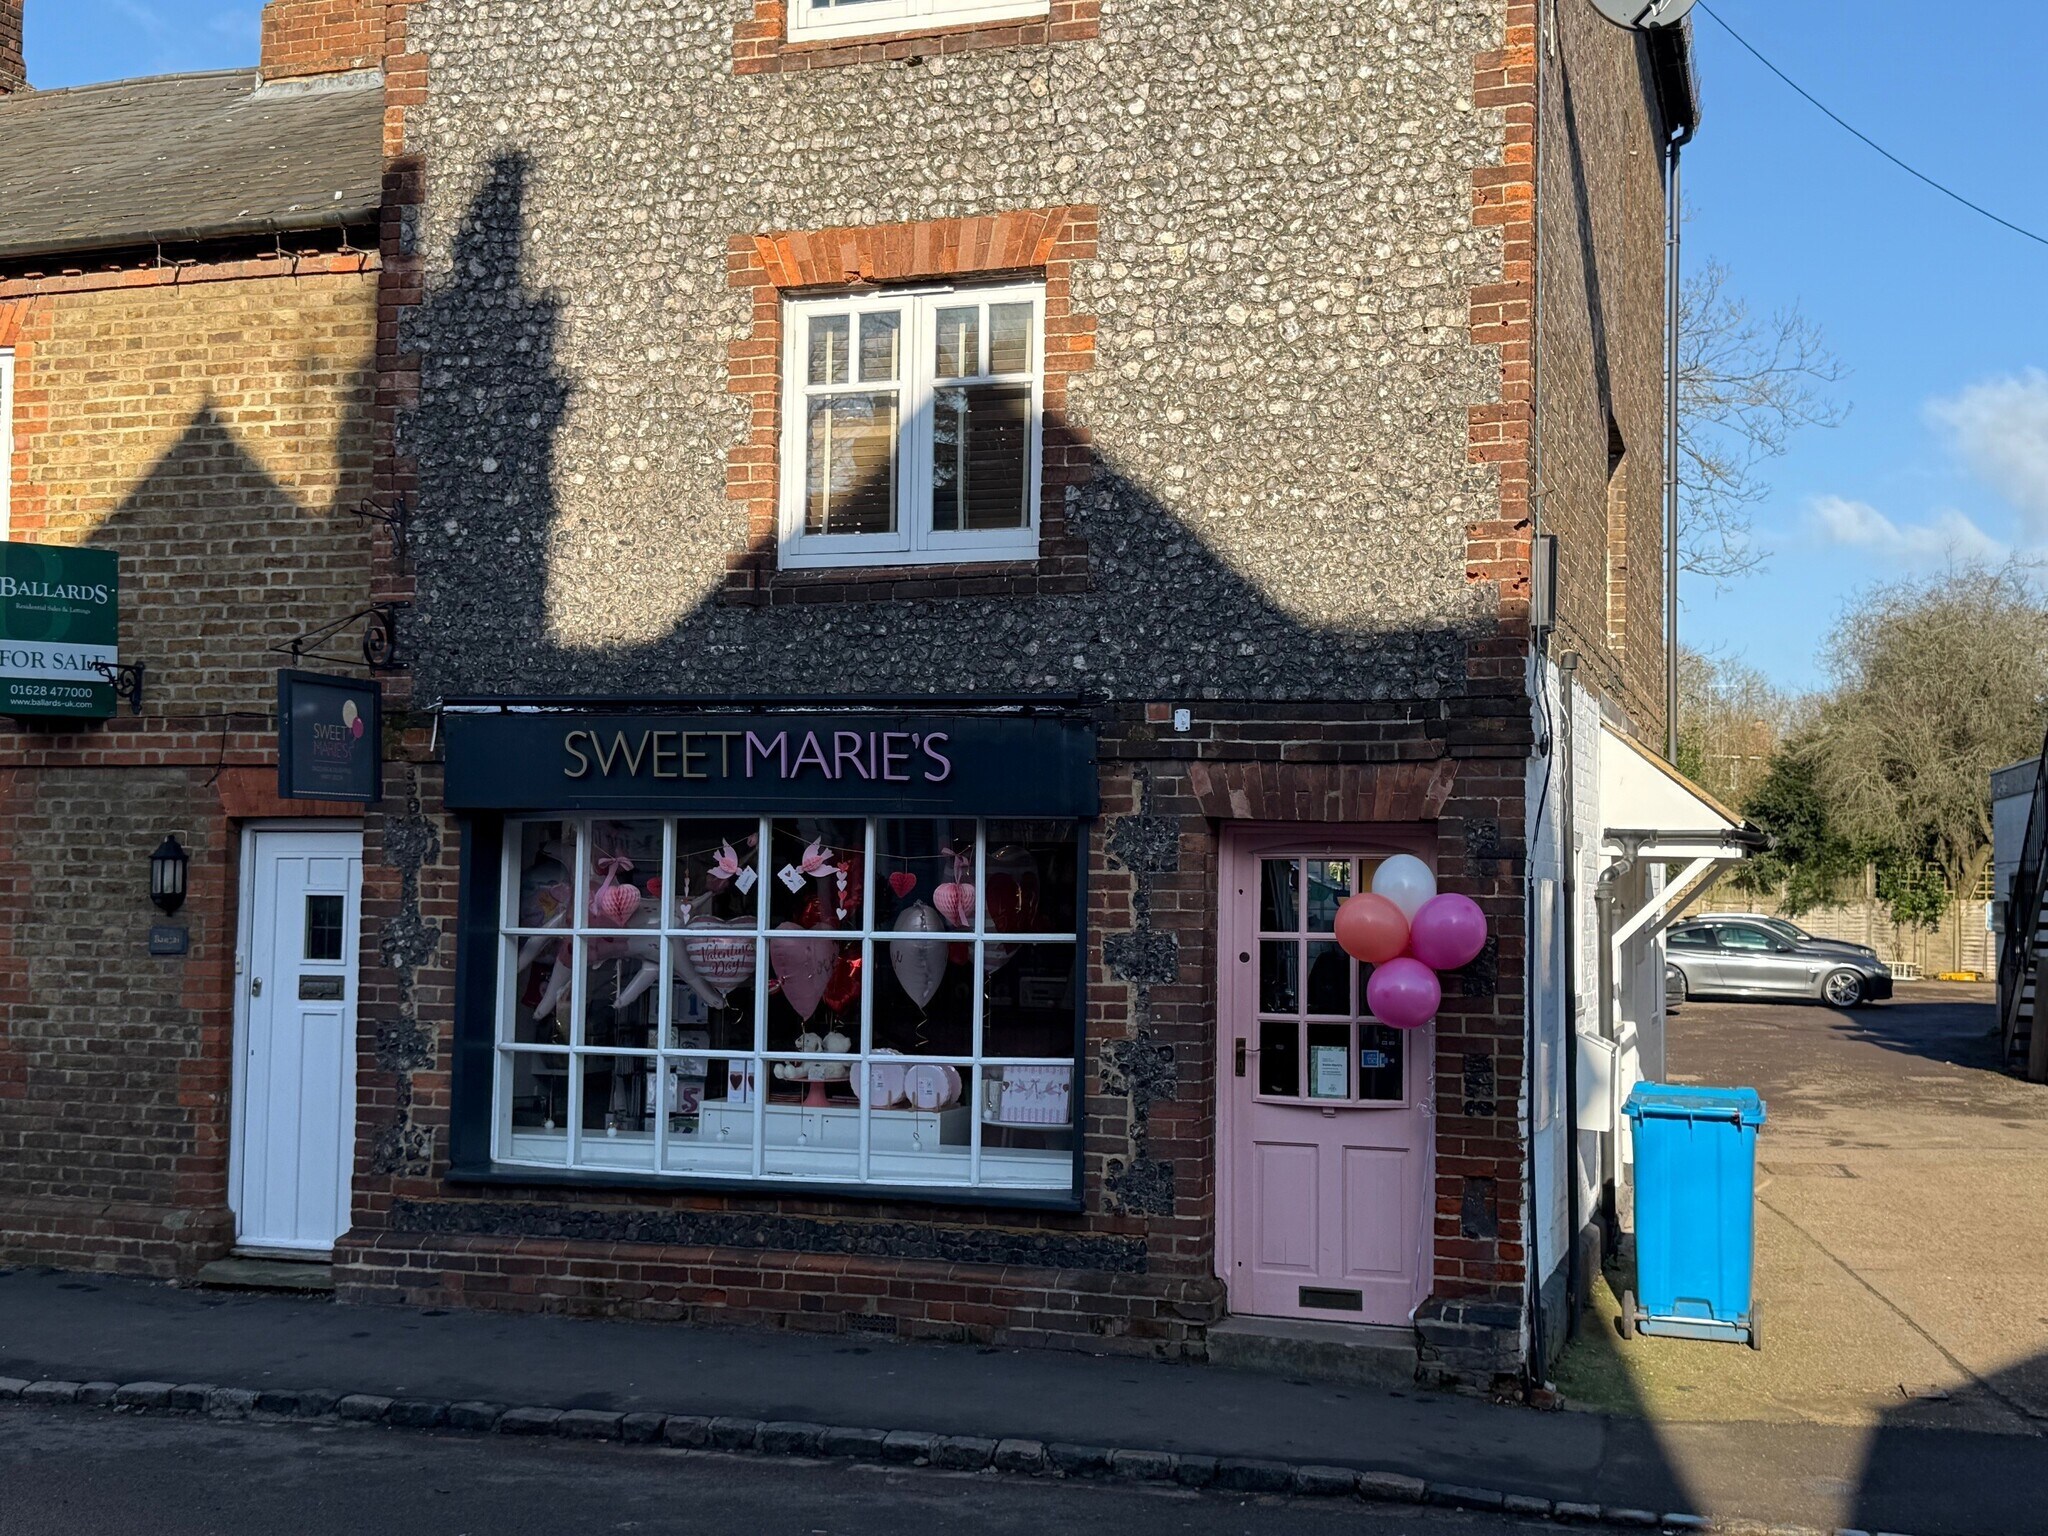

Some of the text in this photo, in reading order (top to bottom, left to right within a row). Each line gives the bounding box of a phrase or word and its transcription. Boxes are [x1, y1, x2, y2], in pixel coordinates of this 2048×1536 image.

[0, 576, 108, 605] BALLARDS
[15, 602, 46, 612] Residential
[0, 650, 106, 672] FOR SALE
[10, 684, 93, 699] 01628 477000
[10, 698, 93, 709] www.ballards-uk.com
[313, 723, 347, 741] SWEET
